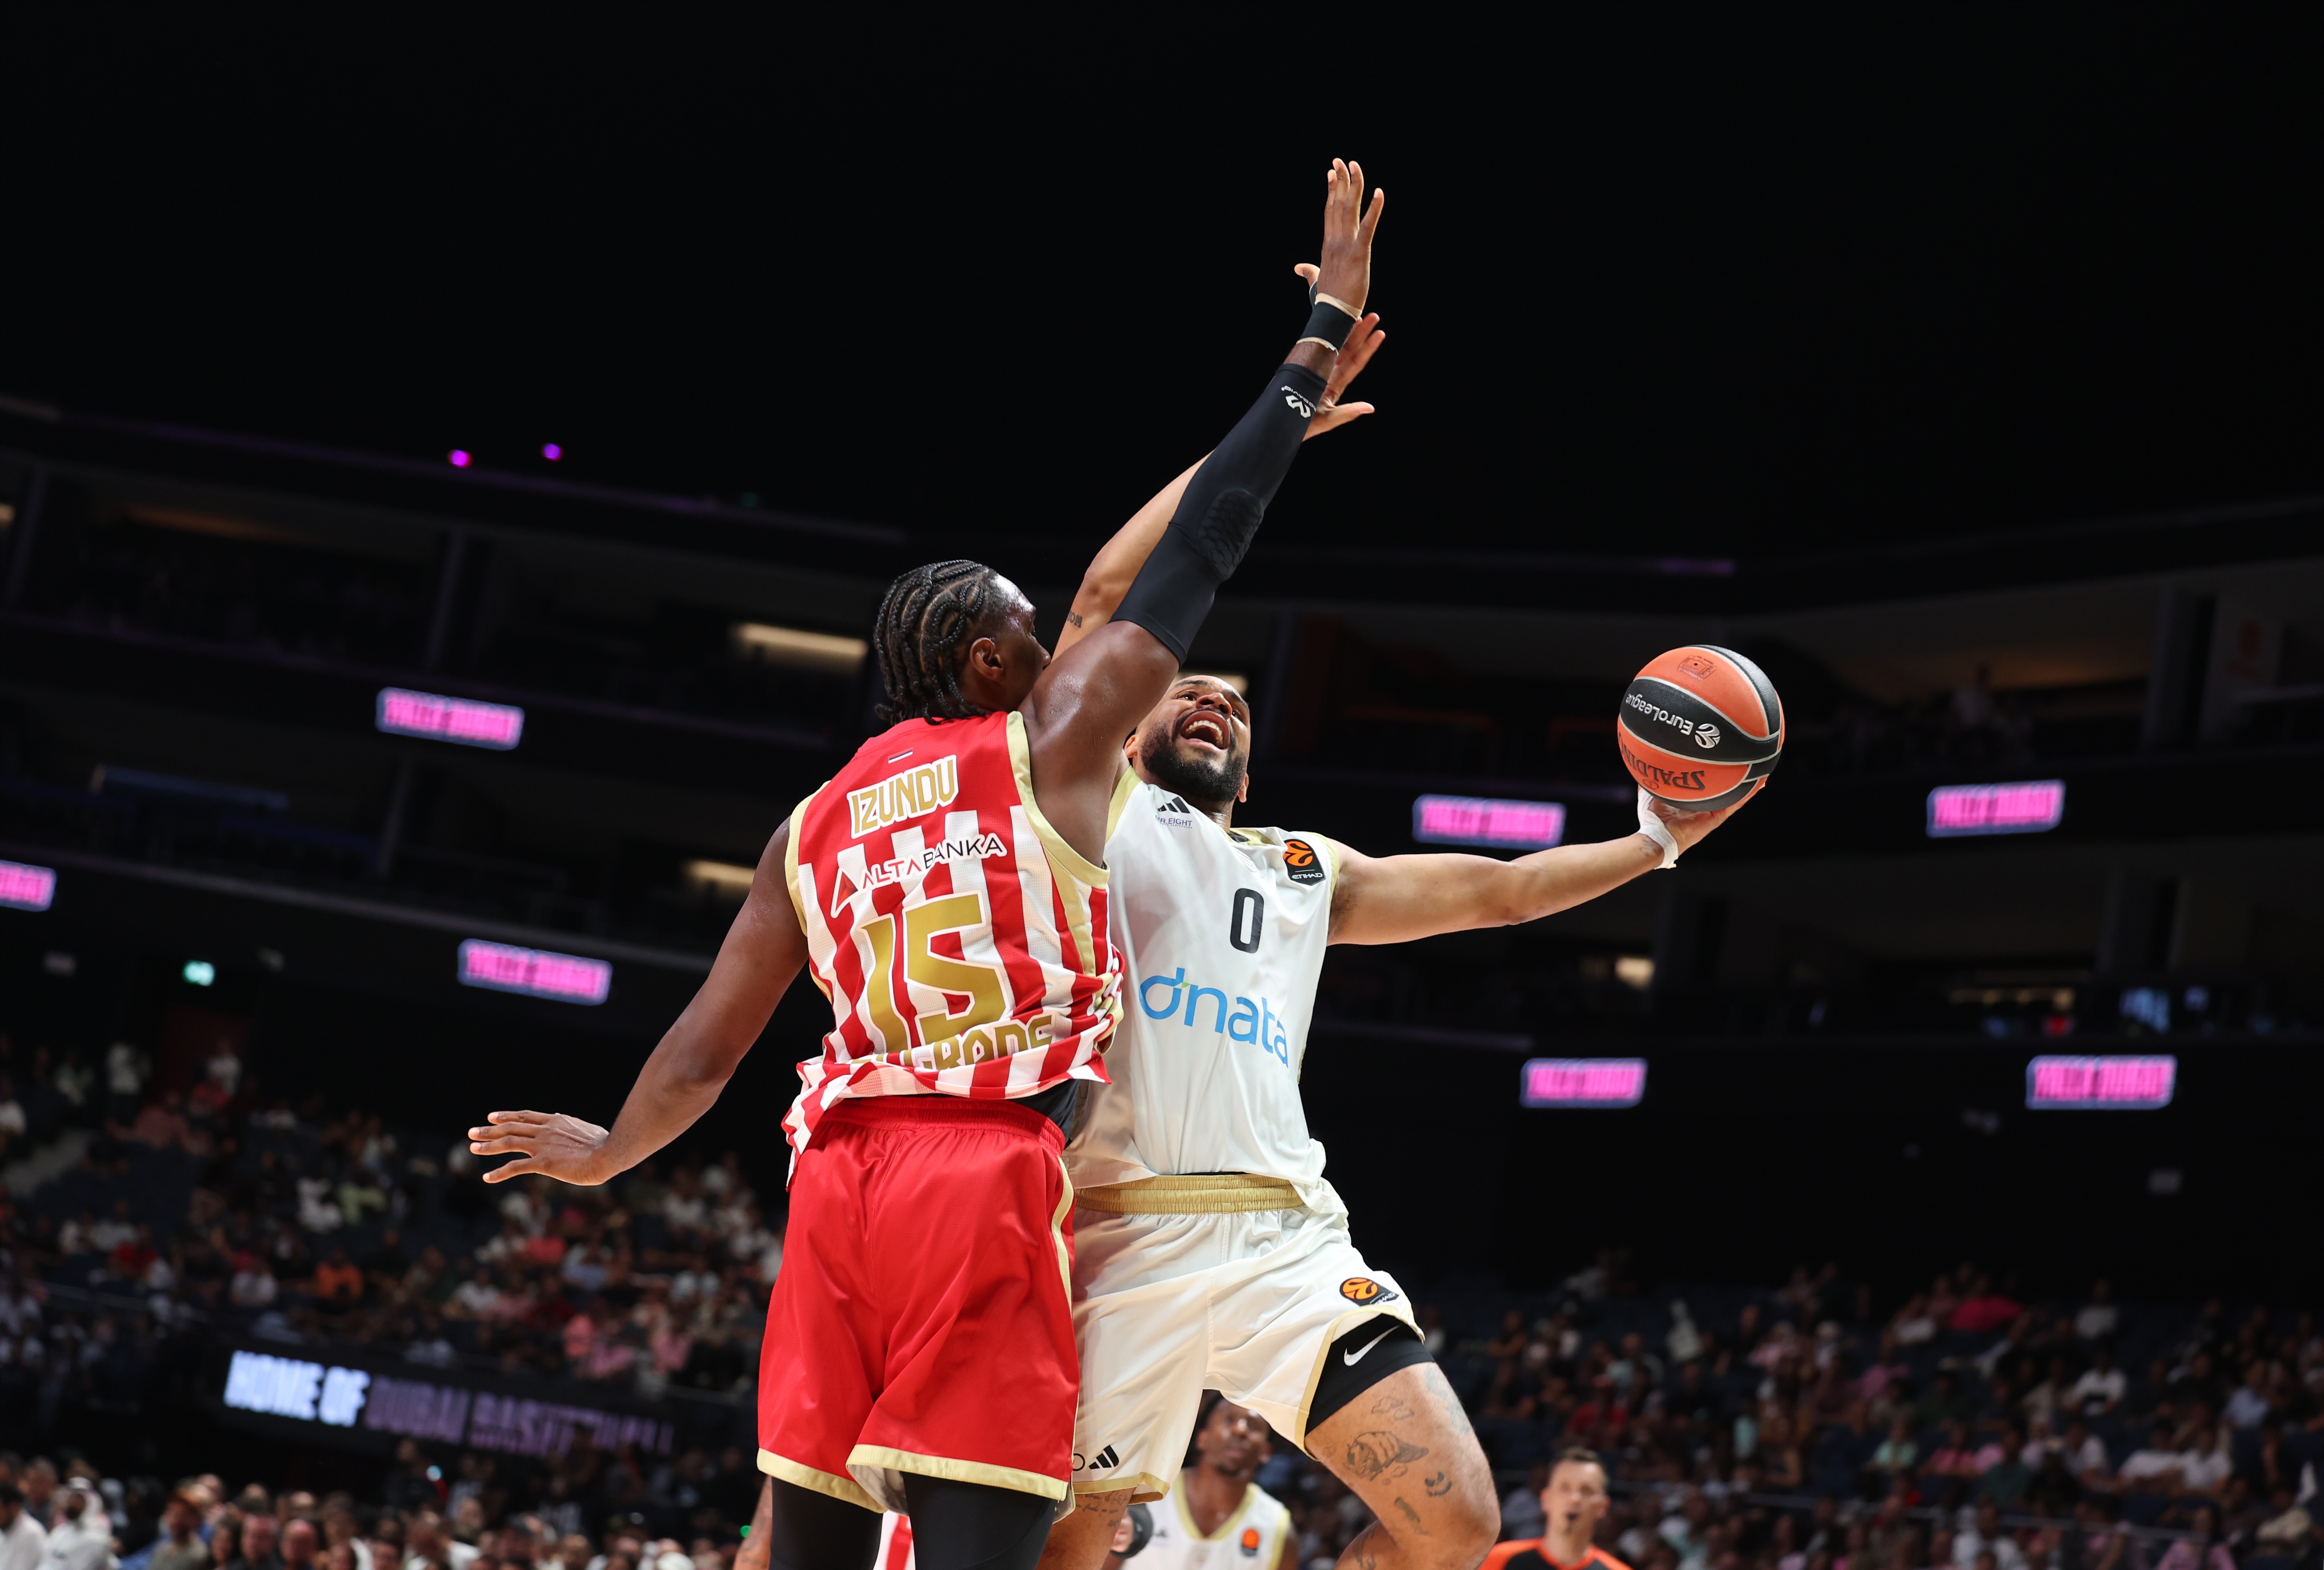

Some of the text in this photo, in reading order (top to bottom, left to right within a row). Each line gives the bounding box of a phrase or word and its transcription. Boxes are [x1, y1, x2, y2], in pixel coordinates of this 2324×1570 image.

[1625, 693, 1694, 736] EuroLeague
[849, 757, 957, 837] IZUNDU
[1229, 887, 1265, 954] 0
[860, 892, 1009, 1054] 15
[1139, 967, 1289, 1069] dnata
